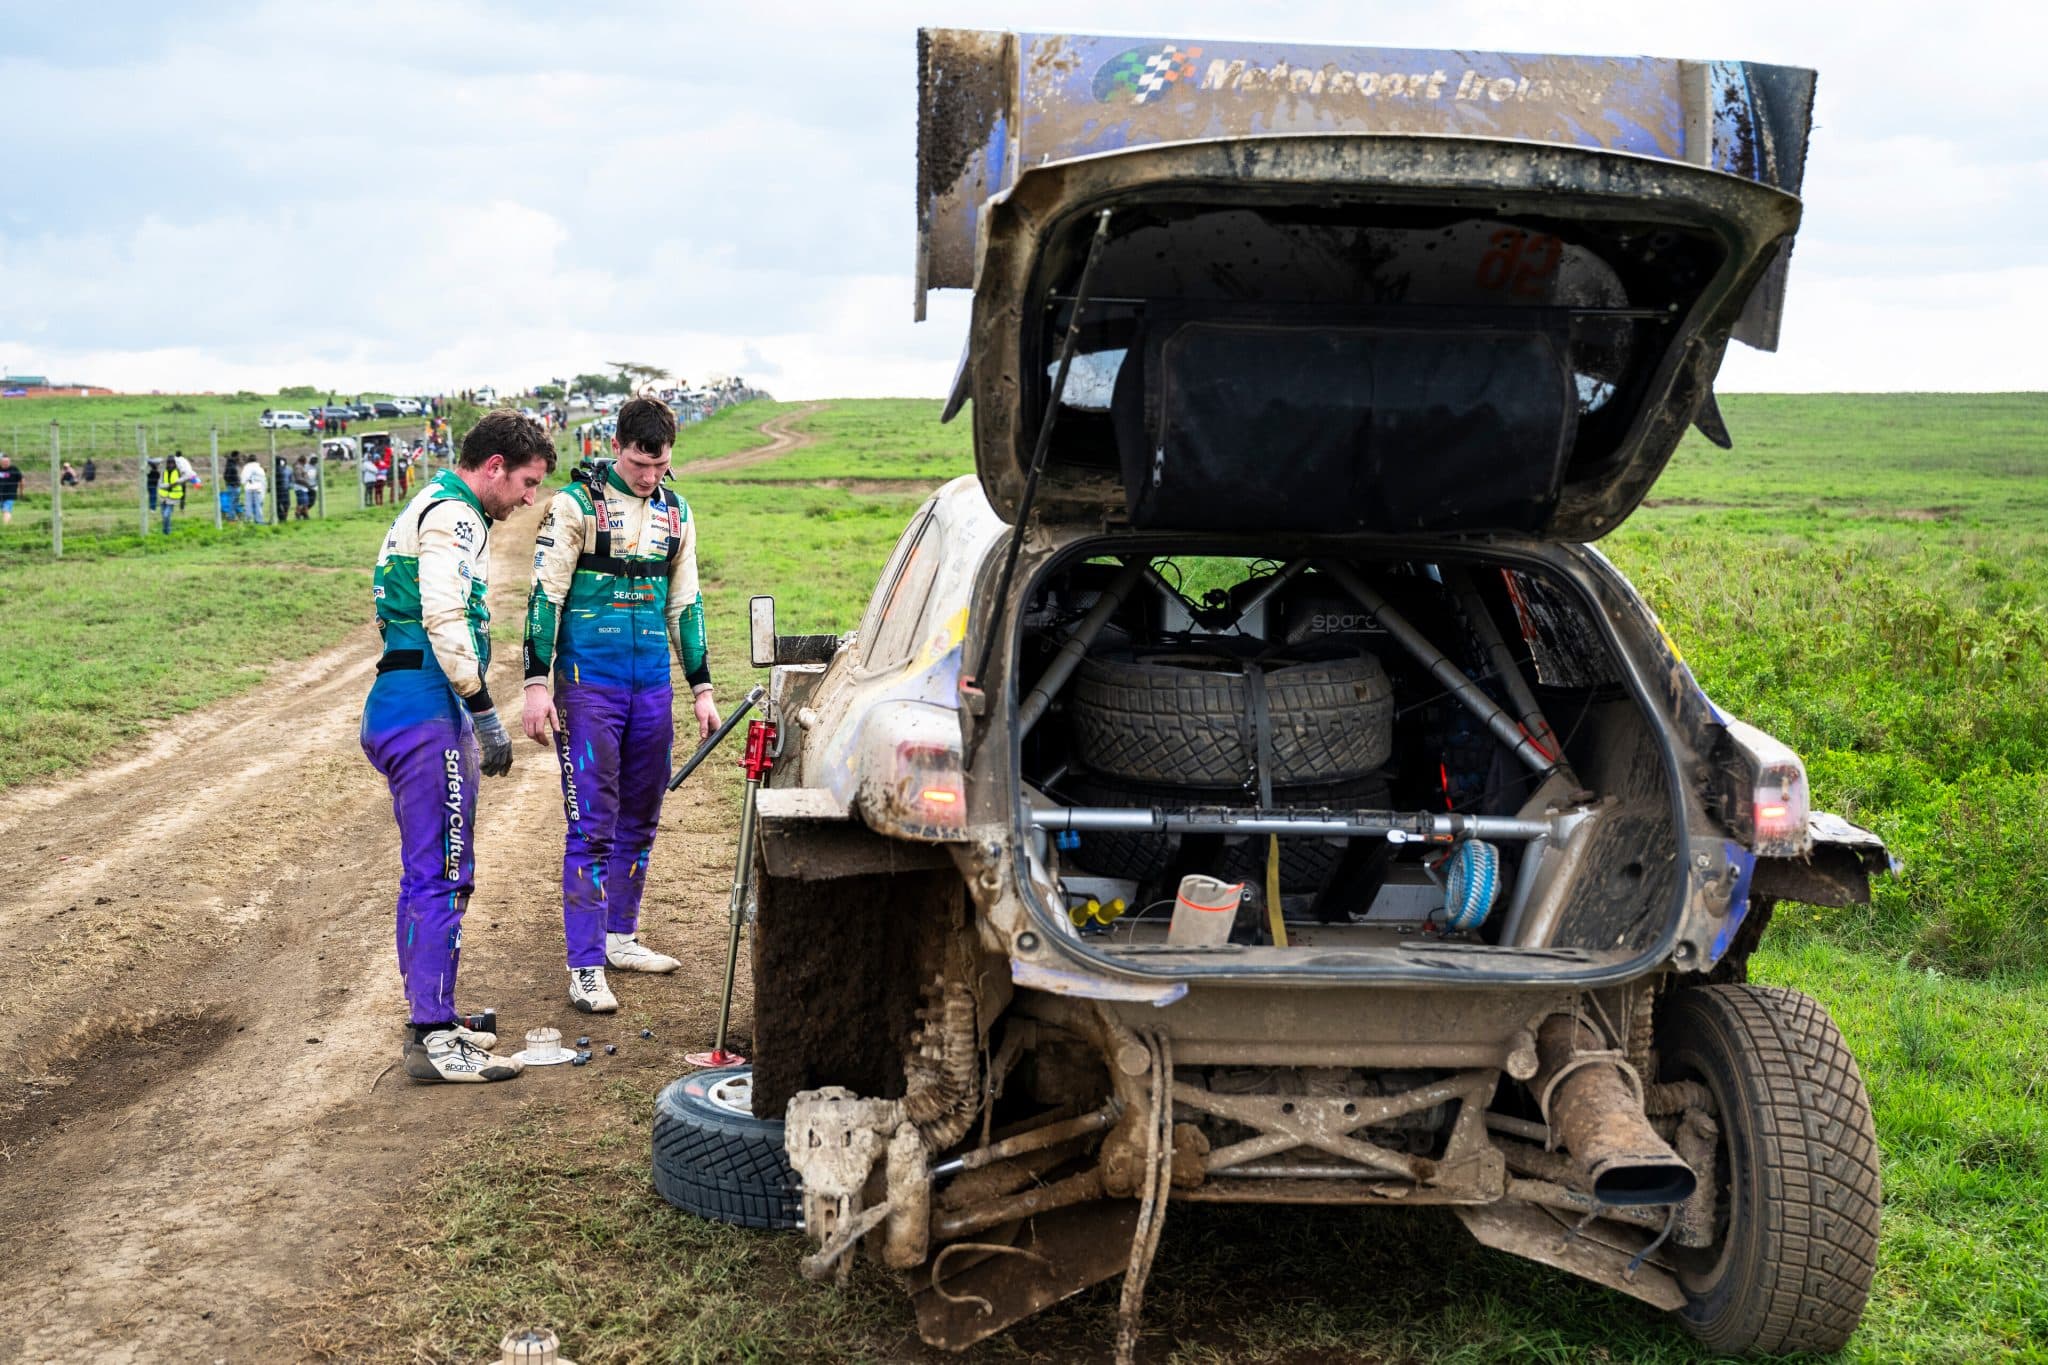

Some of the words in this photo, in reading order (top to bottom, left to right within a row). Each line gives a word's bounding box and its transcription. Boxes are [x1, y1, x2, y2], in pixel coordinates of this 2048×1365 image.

[1311, 614, 1381, 634] sparc
[445, 749, 465, 881] SafetyCulture
[559, 708, 580, 821] SafetyCulture
